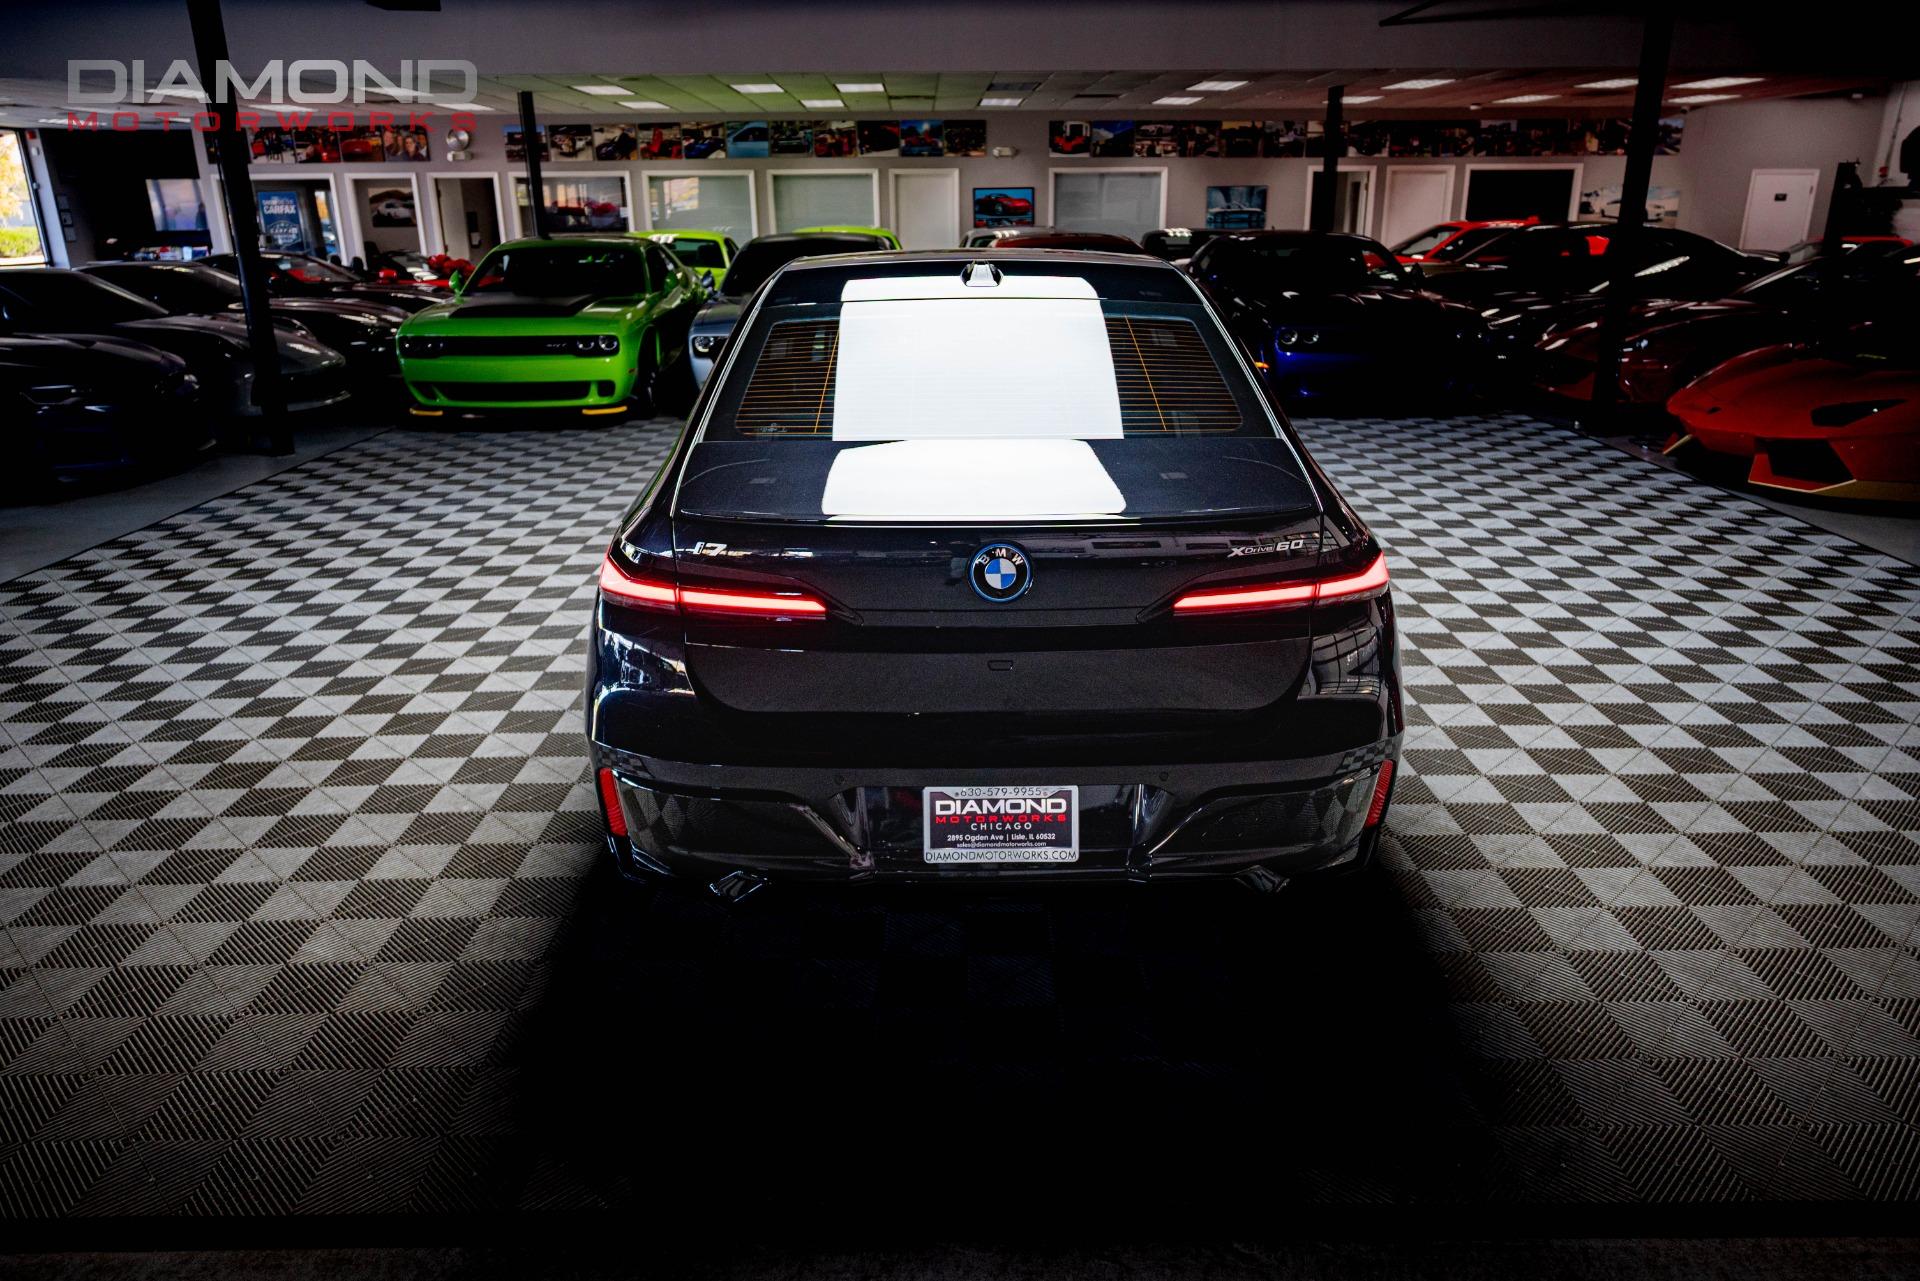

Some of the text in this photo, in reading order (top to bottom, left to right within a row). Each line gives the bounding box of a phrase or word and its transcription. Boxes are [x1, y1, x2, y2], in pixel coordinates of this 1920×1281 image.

[1276, 539, 1304, 551] 60
[979, 548, 1024, 566] BMW
[960, 787, 1042, 797] 630-579-9955
[935, 798, 1067, 815] DIAMOND
[935, 814, 1067, 824] MOTORWORKS
[970, 822, 1032, 831] CHICAGO
[947, 834, 964, 842] 2895
[964, 834, 989, 843] Ogden
[1035, 832, 1056, 840] 60532
[925, 850, 1077, 862] DIAMONDMOTORWORKS.COM
